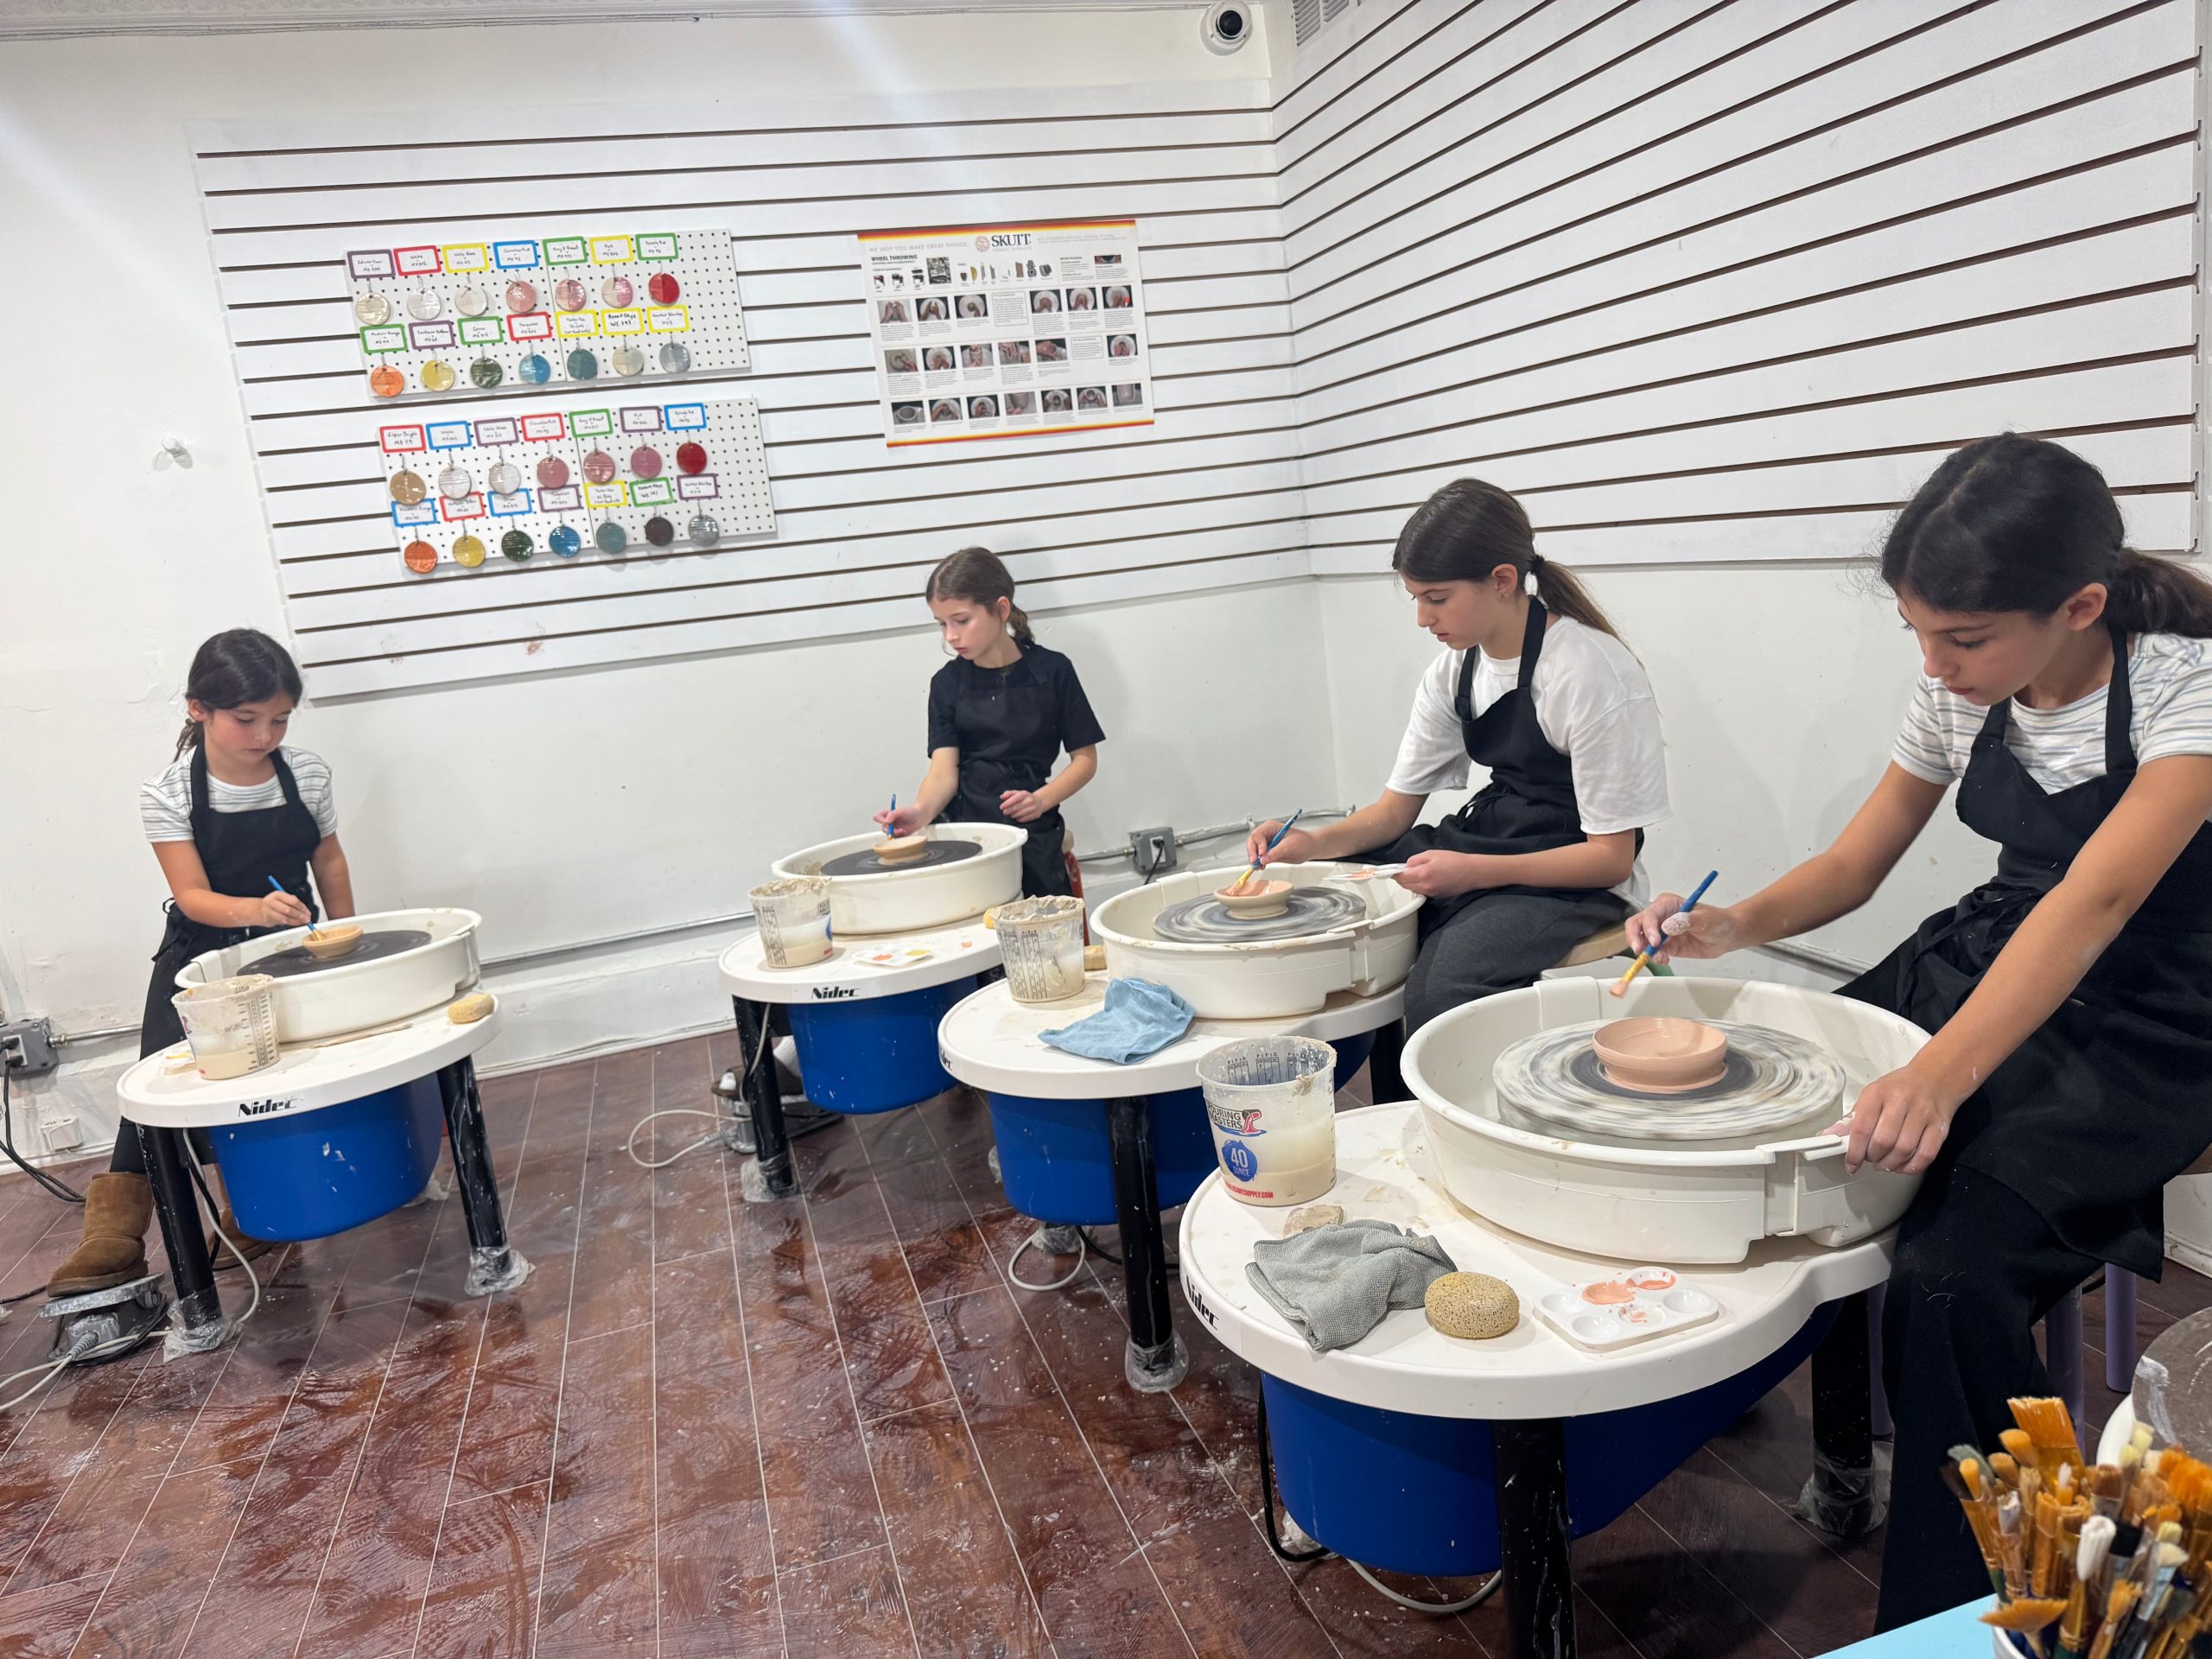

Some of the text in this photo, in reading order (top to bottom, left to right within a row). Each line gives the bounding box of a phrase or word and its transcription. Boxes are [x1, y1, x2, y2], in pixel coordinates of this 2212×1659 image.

[811, 986, 860, 1000] Nidec
[238, 1097, 297, 1117] Nidec
[1231, 1147, 1249, 1168] 40
[1233, 1166, 1250, 1177] OUNCE
[1186, 1274, 1219, 1331] Nidec
